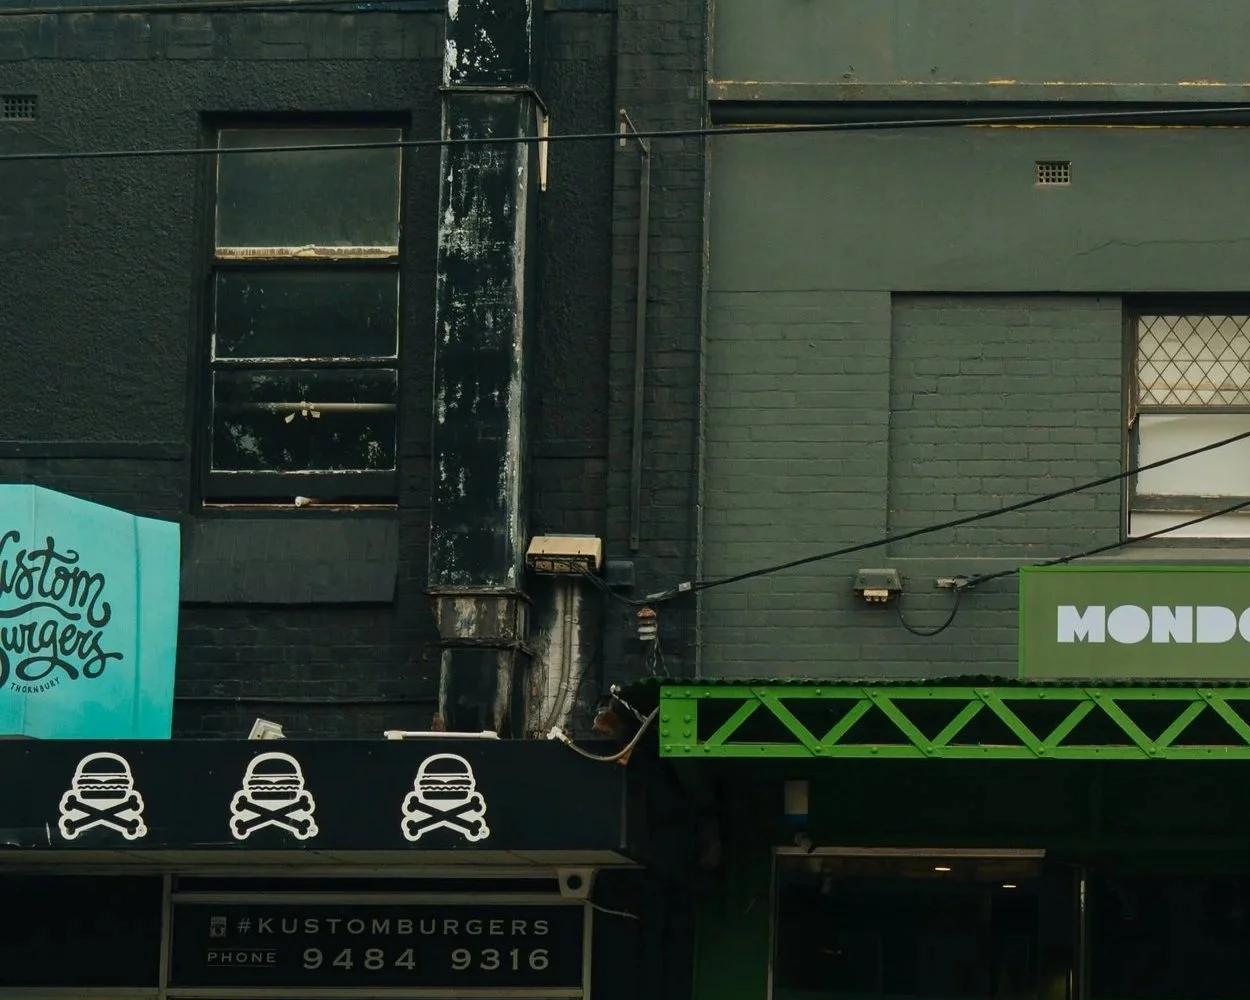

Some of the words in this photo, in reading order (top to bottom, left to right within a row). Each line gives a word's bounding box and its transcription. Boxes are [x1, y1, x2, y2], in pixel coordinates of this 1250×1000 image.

[0, 619, 124, 690] urgers
[10, 677, 61, 694] THORNBURY
[237, 917, 550, 936] #KUSTOMBURGERS
[206, 951, 277, 964] PHONE
[302, 948, 416, 971] 9484
[450, 948, 550, 971] 9316
